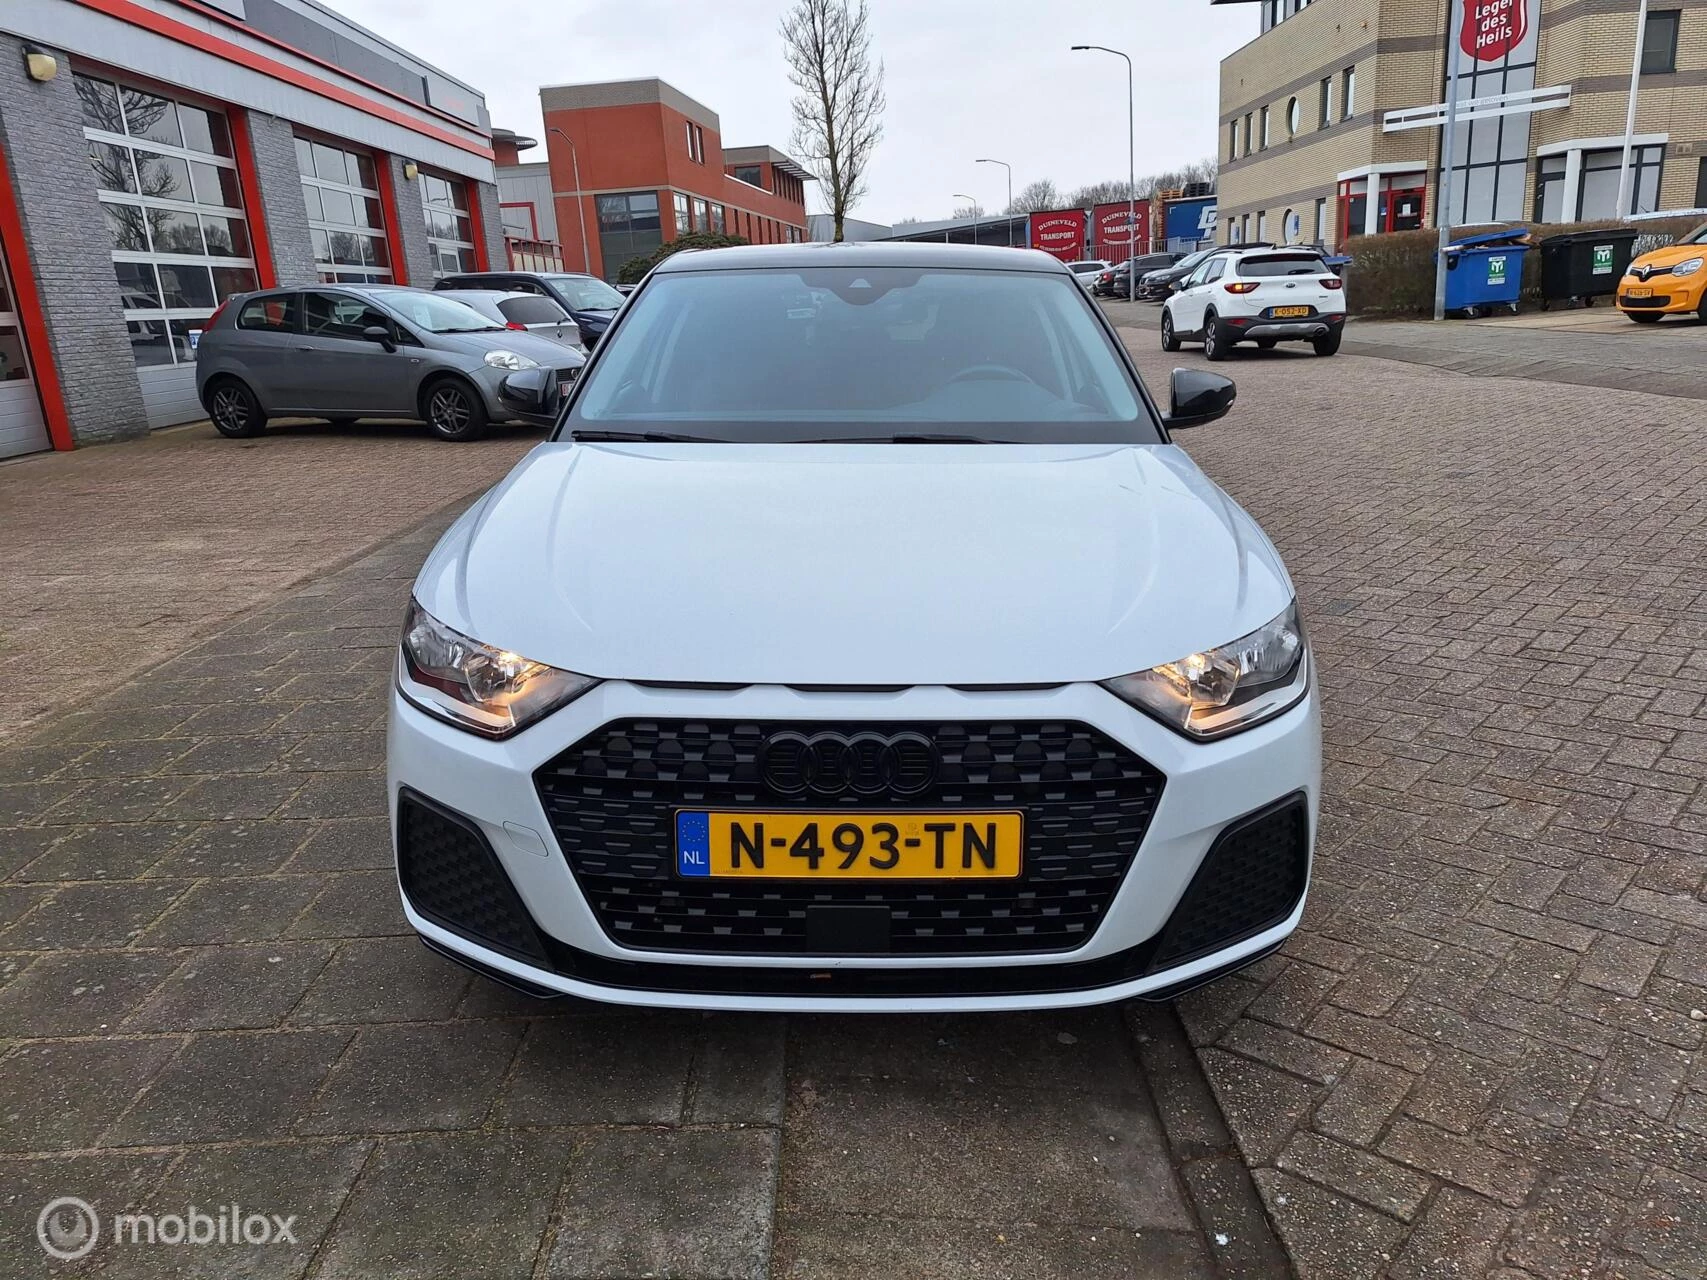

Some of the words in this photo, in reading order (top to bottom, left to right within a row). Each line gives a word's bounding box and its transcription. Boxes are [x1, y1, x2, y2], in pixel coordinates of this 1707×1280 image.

[1481, 13, 1507, 32] des
[1476, 26, 1513, 49] Heils
[1038, 219, 1078, 231] DUINEVELD
[1040, 231, 1075, 241] TRANSPORT
[683, 850, 705, 865] NL
[730, 821, 997, 869] N-493-TN
